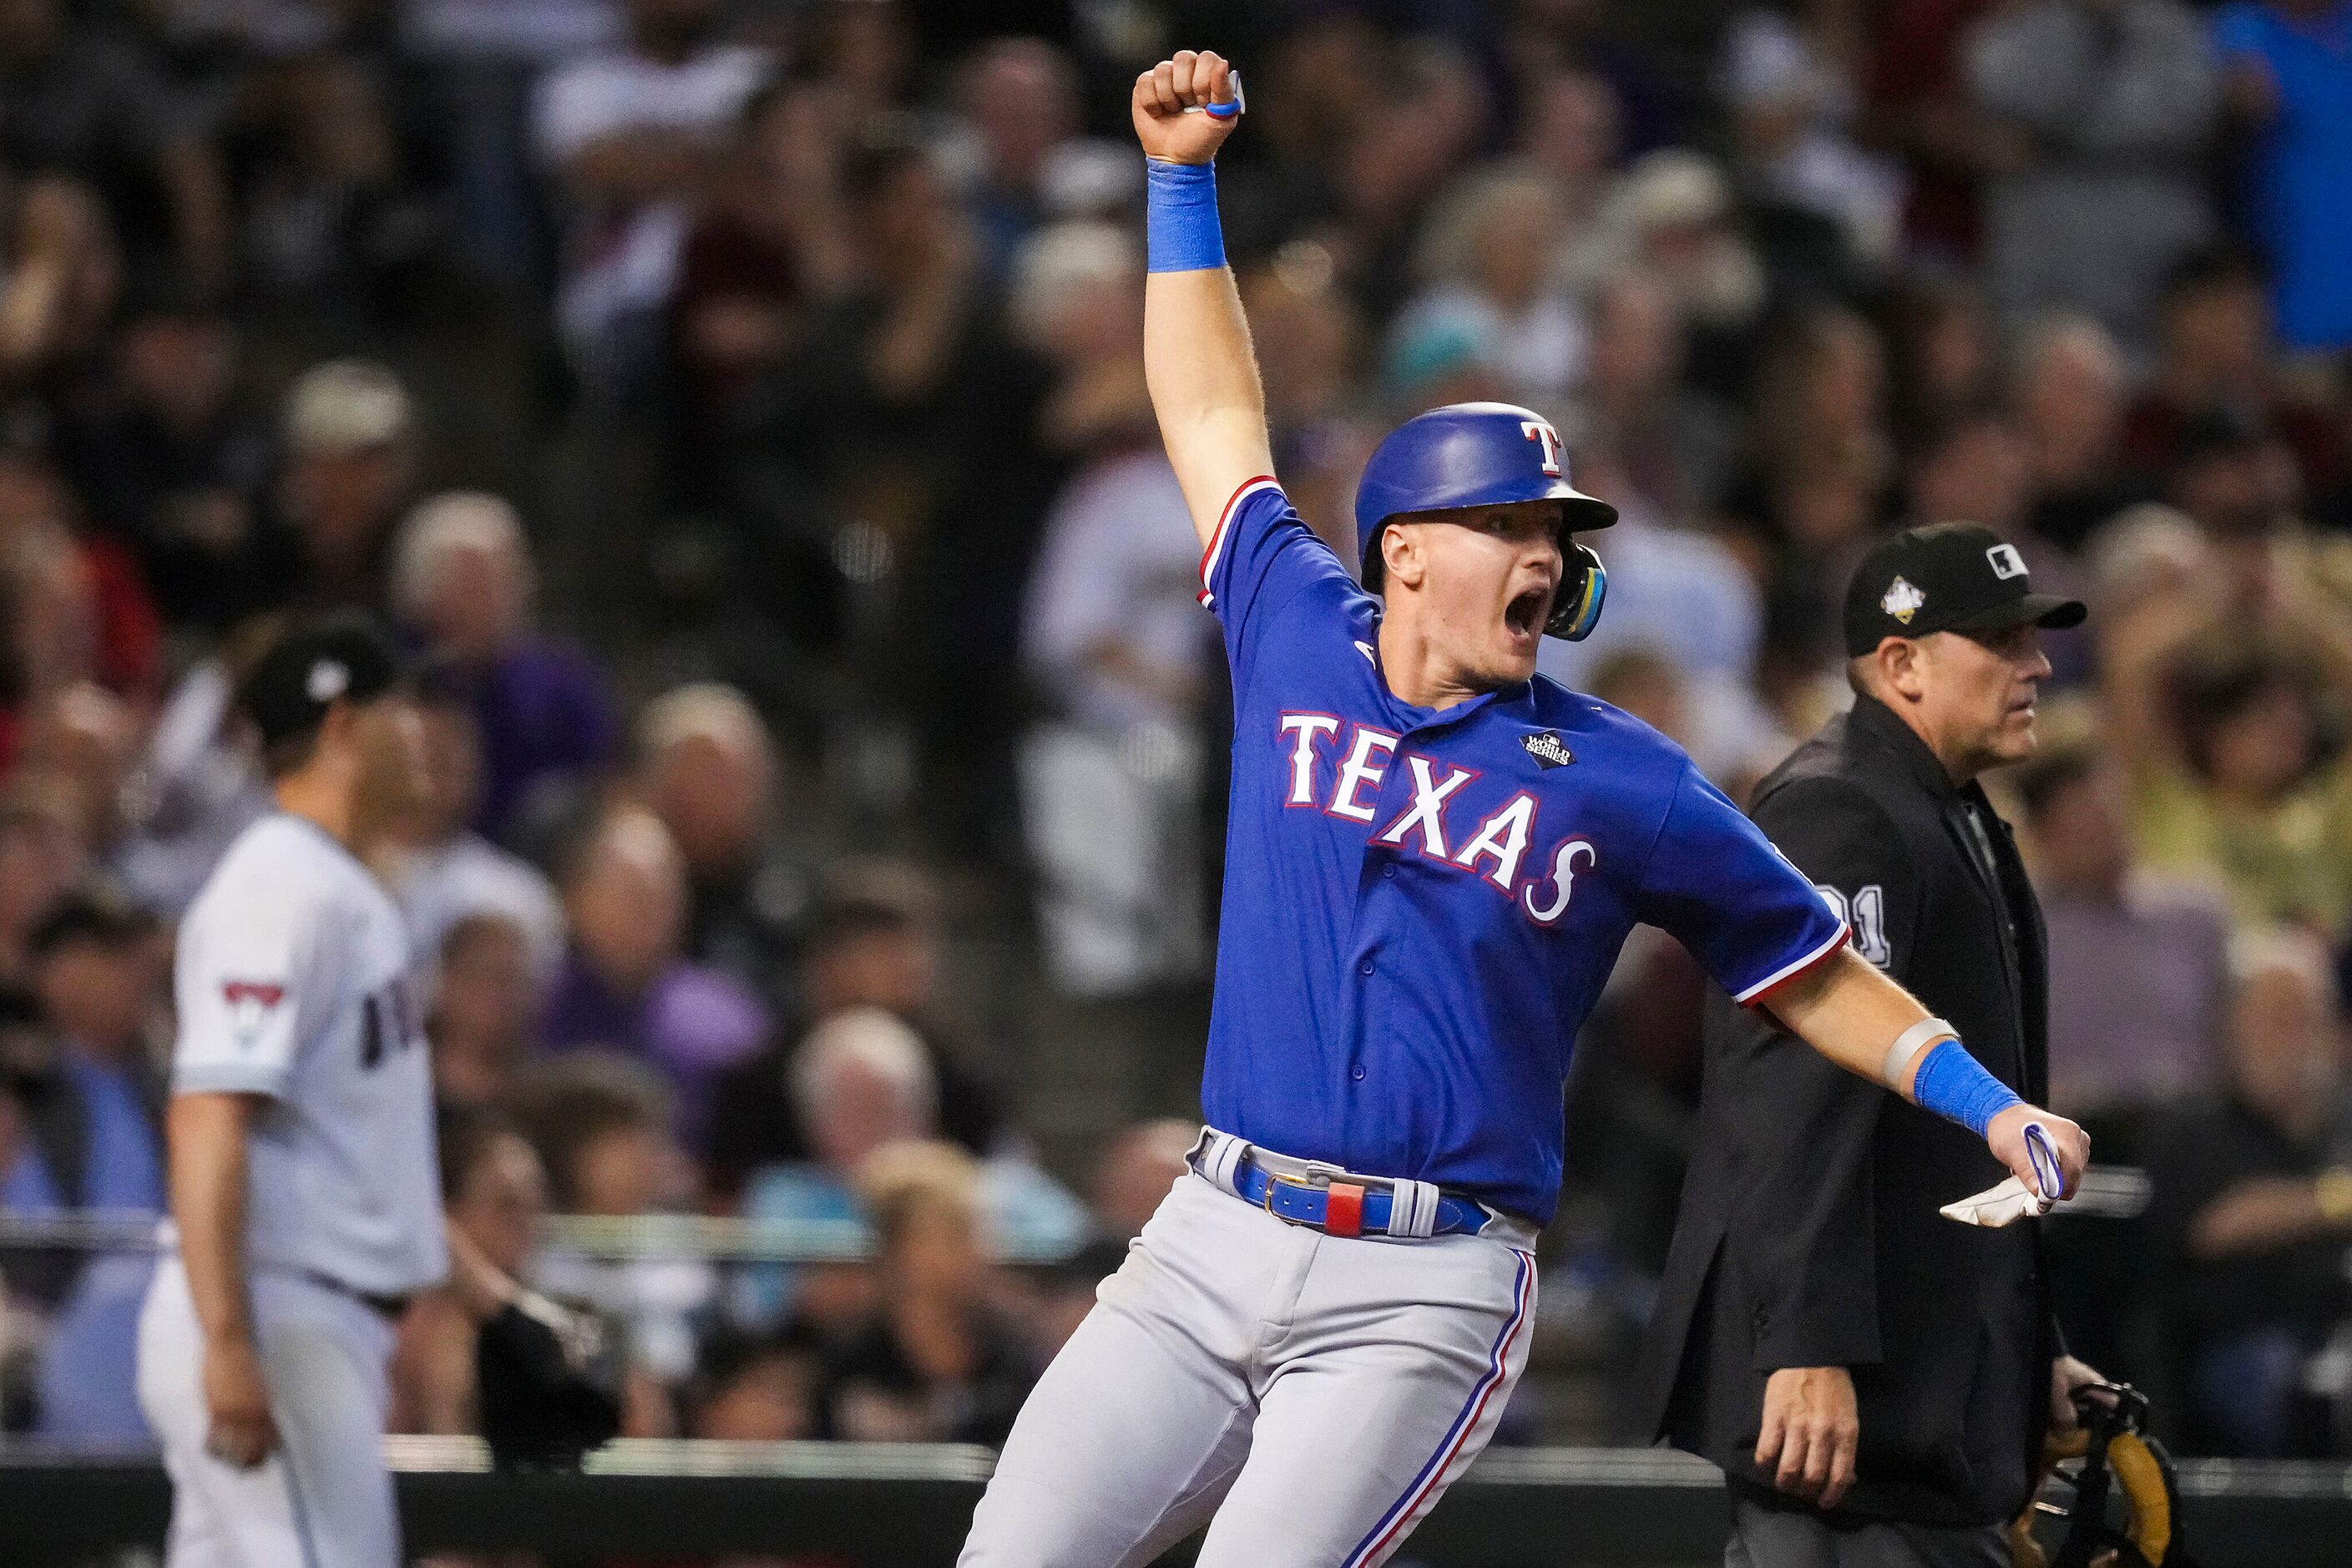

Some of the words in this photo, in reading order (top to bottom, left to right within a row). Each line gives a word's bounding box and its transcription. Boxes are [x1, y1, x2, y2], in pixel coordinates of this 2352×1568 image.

[1520, 421, 1561, 478] T
[1525, 742, 1568, 766] SERIES
[1528, 735, 1571, 759] WORLD
[1277, 710, 1597, 928] TEXAS
